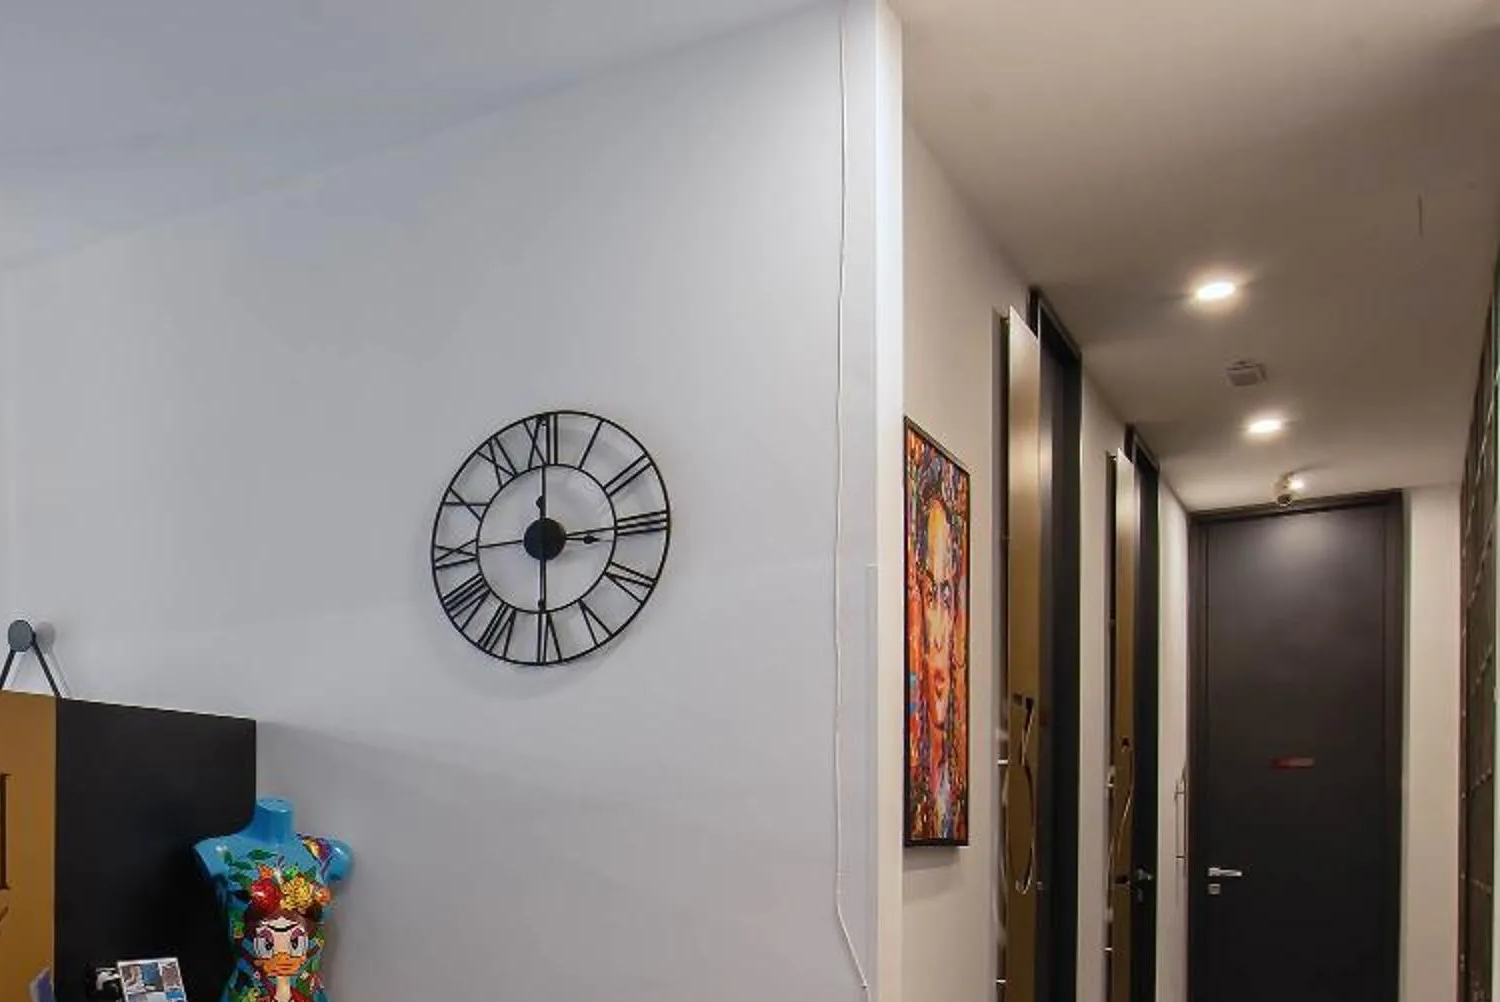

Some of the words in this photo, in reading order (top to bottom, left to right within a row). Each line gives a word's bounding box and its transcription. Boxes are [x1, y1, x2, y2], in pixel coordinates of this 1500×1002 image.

[474, 436, 518, 486] XI
[523, 413, 558, 470] XII
[603, 453, 652, 497] II
[443, 487, 490, 522] X
[615, 510, 668, 536] III
[434, 538, 477, 570] IX
[605, 561, 657, 605] IV
[536, 611, 563, 664] VI
[578, 598, 614, 647] V
